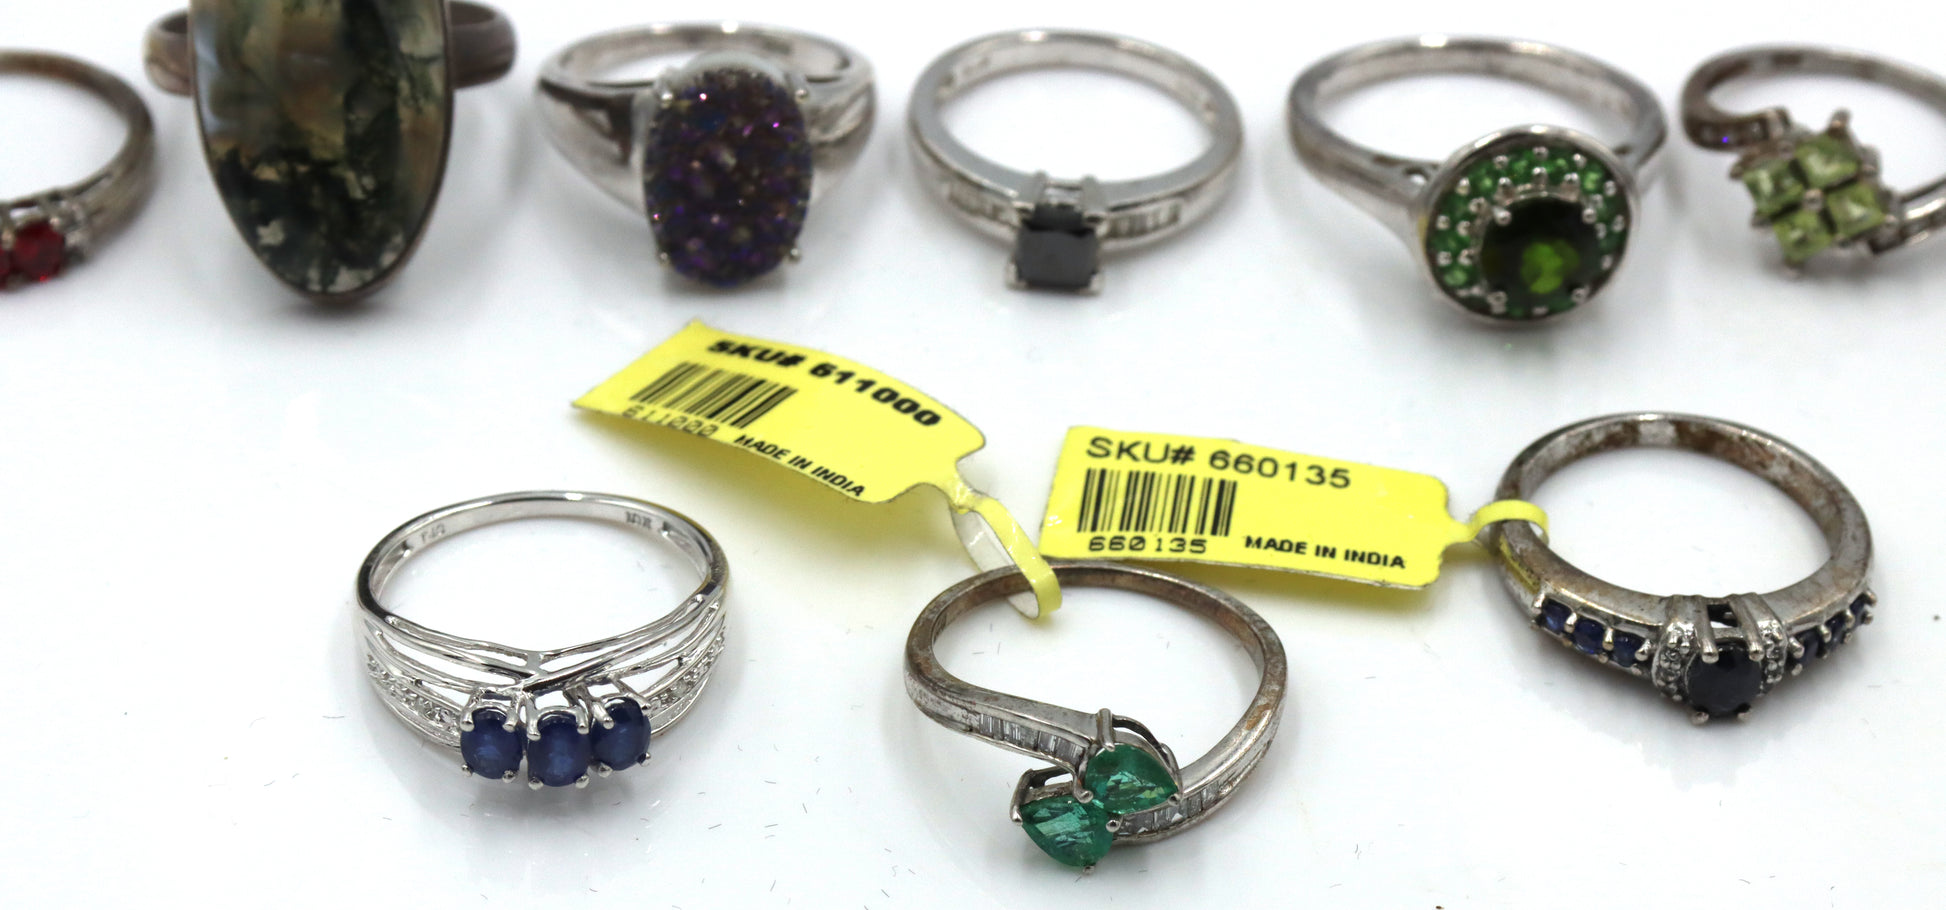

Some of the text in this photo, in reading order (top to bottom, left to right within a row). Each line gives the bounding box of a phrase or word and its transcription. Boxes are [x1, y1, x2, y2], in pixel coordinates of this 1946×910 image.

[707, 340, 942, 427] SKU# 611000
[733, 434, 866, 497] MADE IN INDIA
[1086, 436, 1352, 489] SKU# 660135
[1088, 535, 1208, 554] 660135
[1244, 535, 1406, 570] MADE IN INDIA
